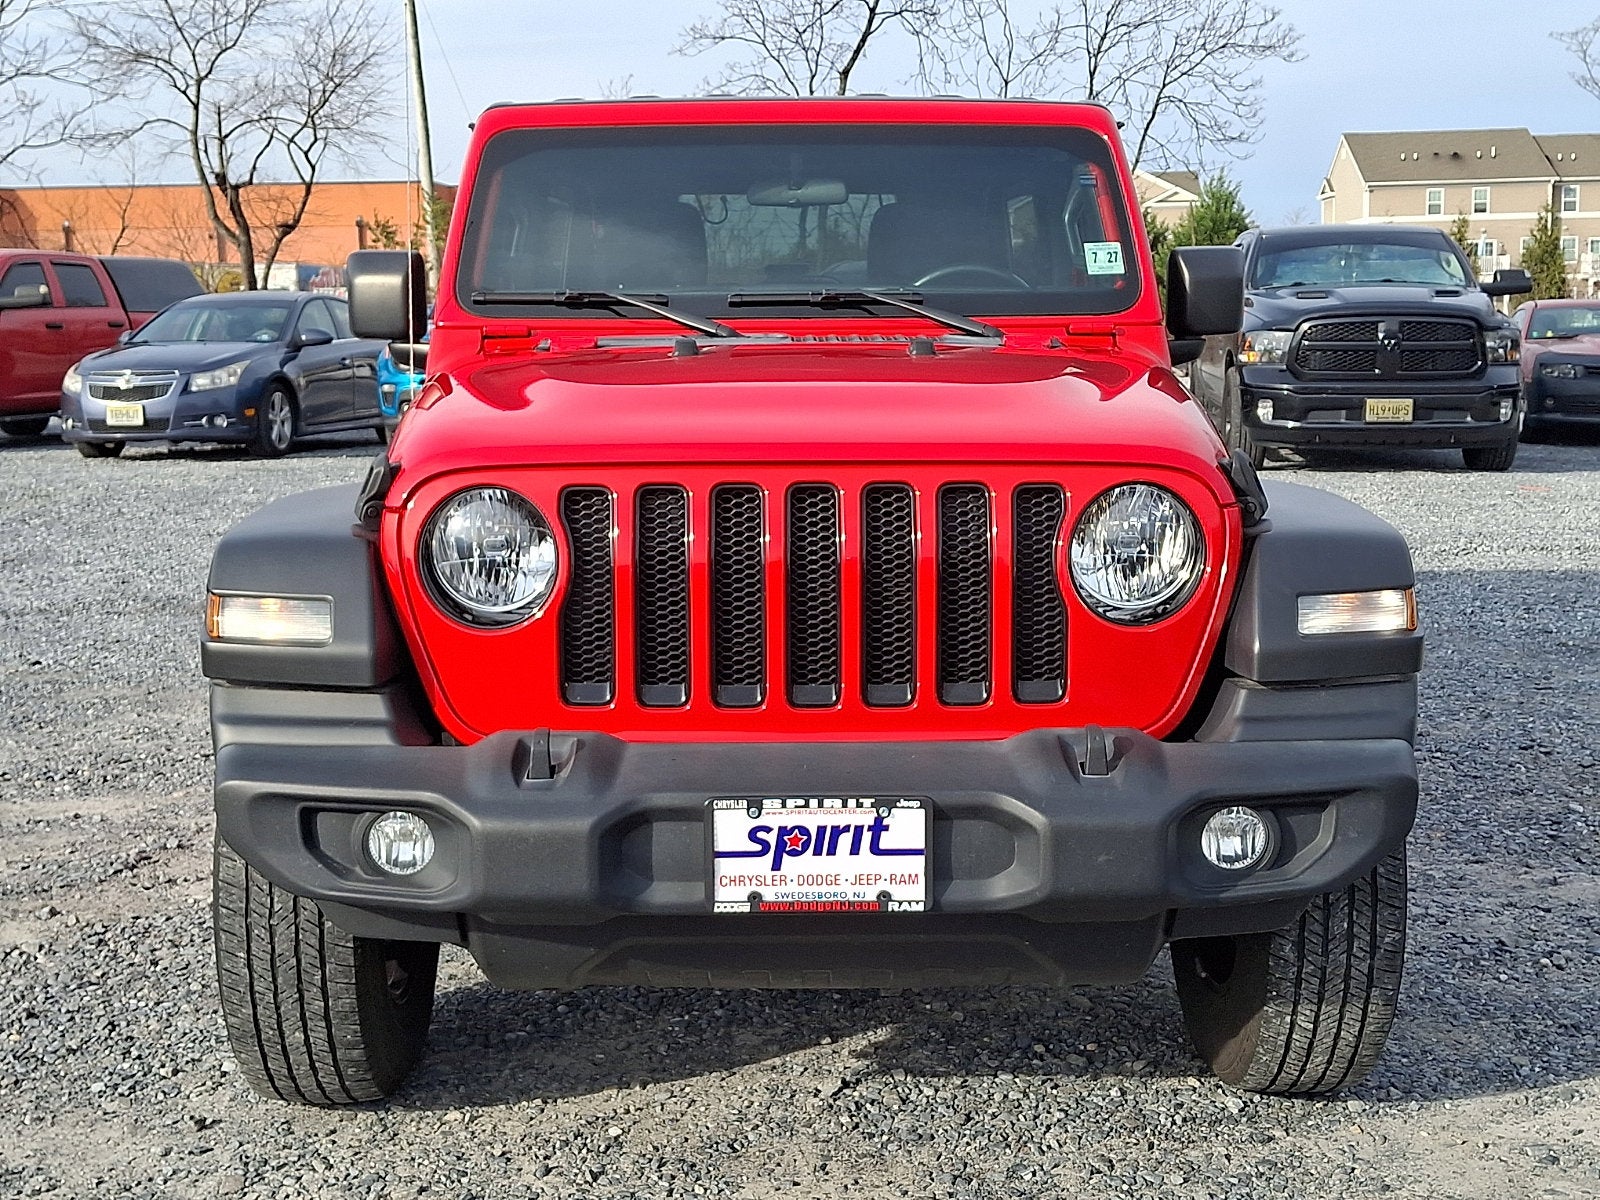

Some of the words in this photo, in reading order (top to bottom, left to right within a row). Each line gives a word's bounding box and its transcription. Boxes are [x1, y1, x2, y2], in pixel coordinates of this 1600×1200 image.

[1091, 252, 1097, 263] 7
[1107, 251, 1118, 263] 27
[713, 799, 748, 809] CHRYSLER
[762, 798, 876, 809] SPIRIT
[896, 798, 921, 809] Jeep
[714, 816, 925, 872] spirit
[719, 874, 788, 888] CHRYSLER
[797, 873, 841, 886] DODGE
[850, 873, 882, 886] JEEP
[889, 873, 919, 886] RAM
[774, 891, 850, 901] SWEDESBORO,
[852, 891, 867, 899] NJ
[759, 900, 880, 912] www.DodgeNJ.com
[887, 901, 925, 912] RAM
